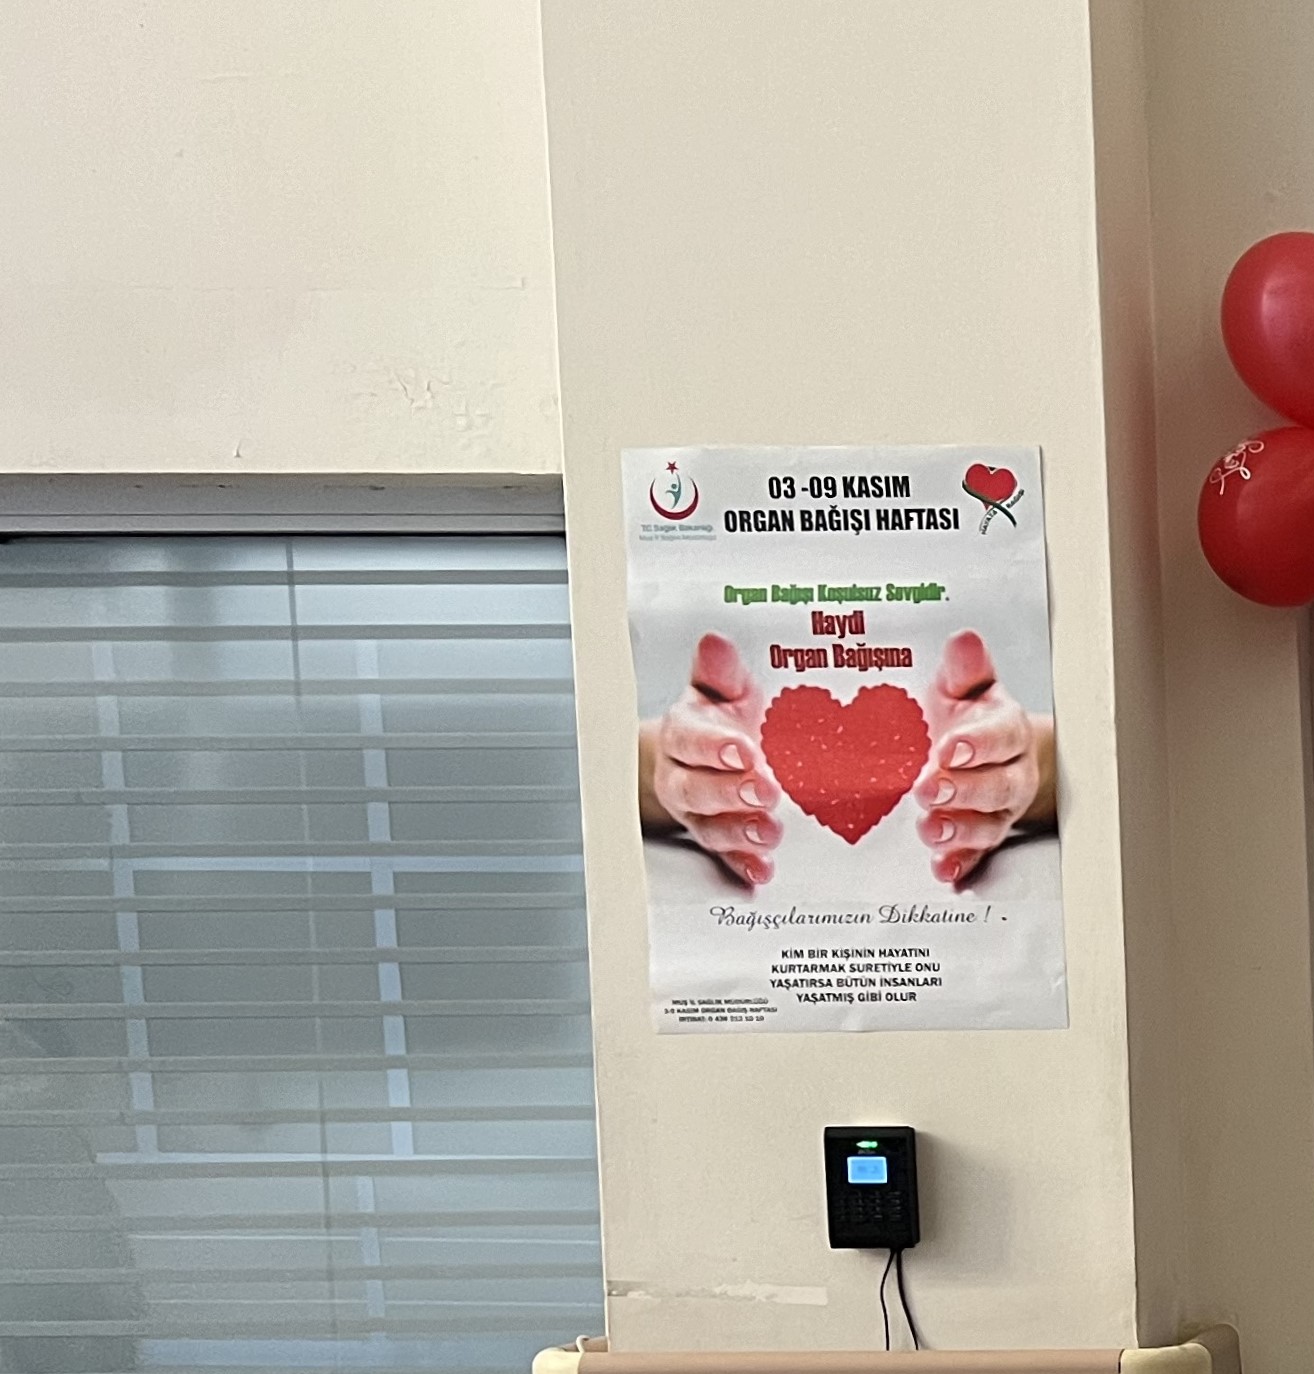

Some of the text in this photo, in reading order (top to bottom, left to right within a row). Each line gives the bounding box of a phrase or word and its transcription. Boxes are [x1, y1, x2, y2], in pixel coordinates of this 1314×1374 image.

[768, 475, 911, 500] 03 -09 KASIM
[724, 504, 960, 535] ORGAN BAĞIŞI HAFTASI
[724, 585, 768, 606] Organ
[771, 584, 814, 605] Bağışı
[817, 584, 882, 605] Koşulsuz
[811, 610, 866, 640] Haydi
[770, 642, 913, 672] Organ Bağışına
[710, 905, 978, 931] Bağışçılarımızın Dikkatine
[782, 947, 930, 961] KİM BİR KİŞİNİN HAYATINI
[771, 962, 941, 974] KURTARMAK SURETİYLE ONU
[770, 975, 942, 991] YAŞATIRSA BÜTÜN İNSANLARI
[796, 990, 917, 1005] YAŞATMIŞ GİBİ OLUR
